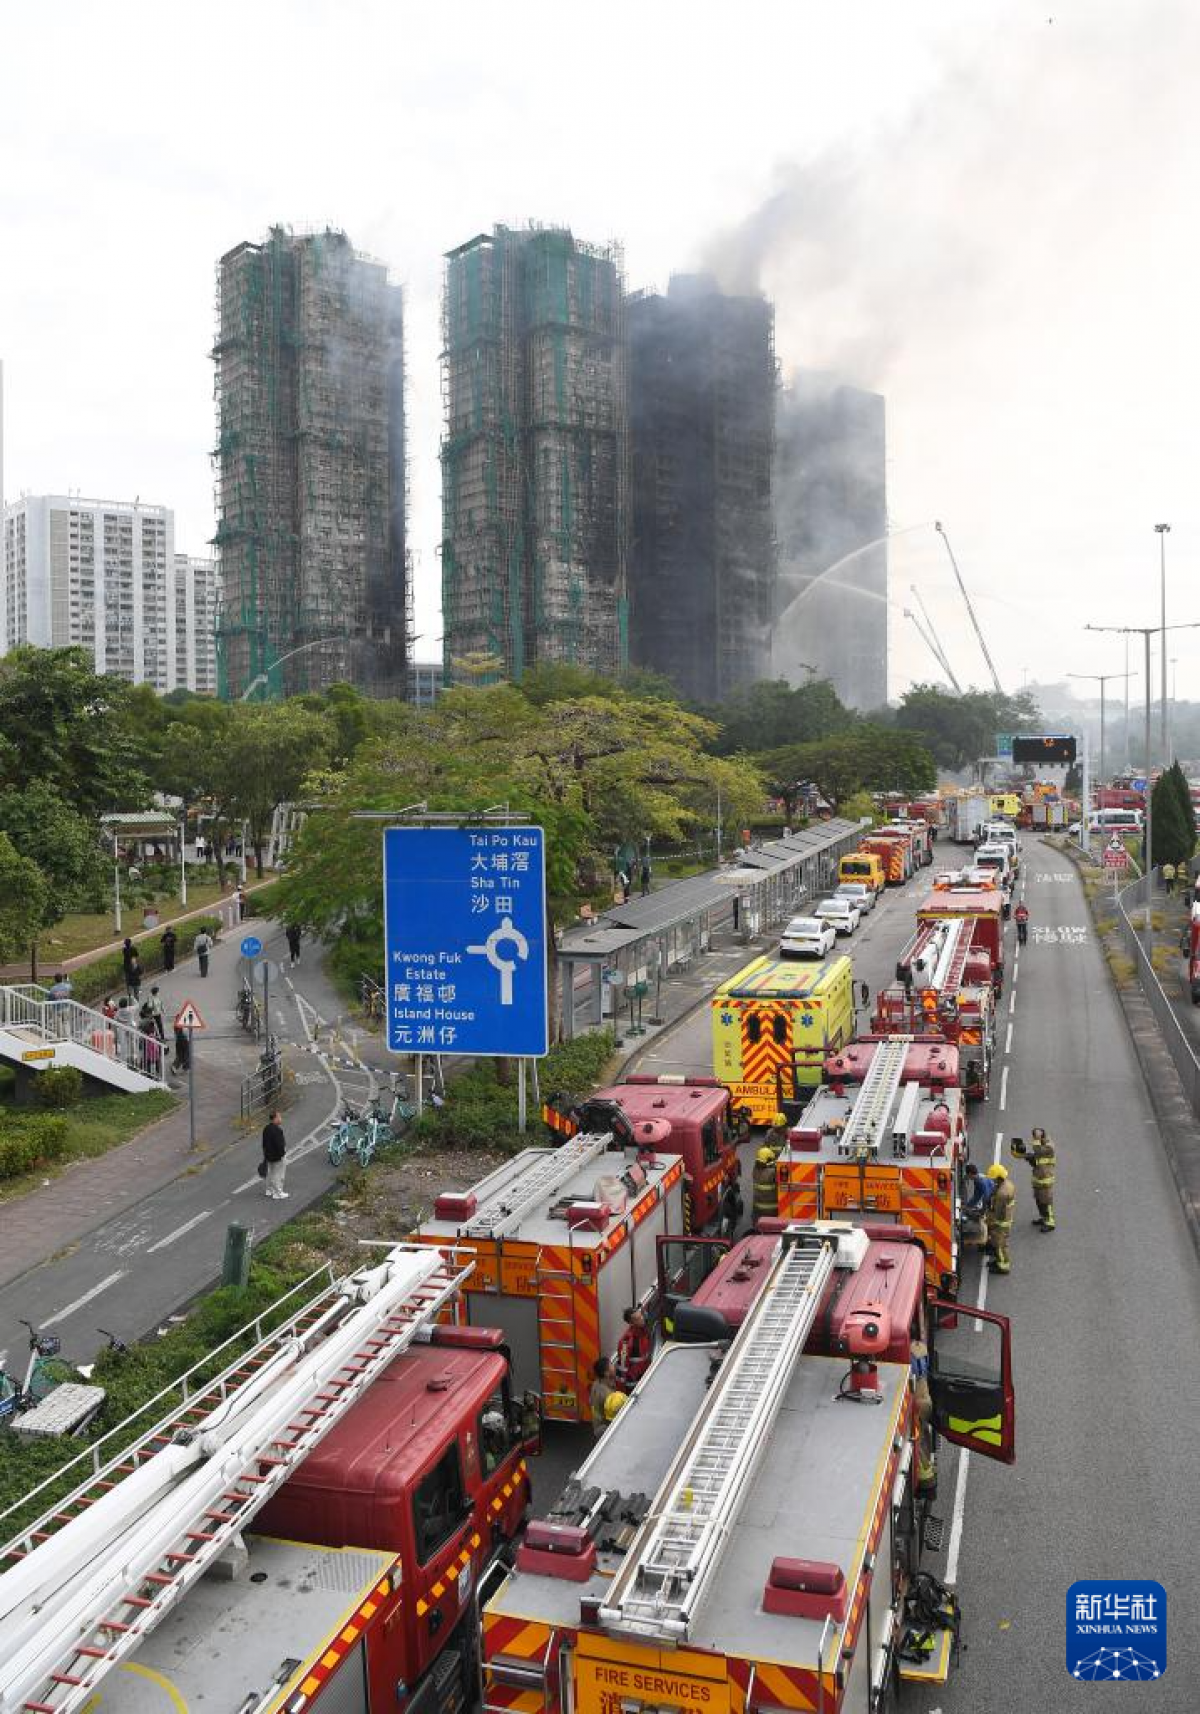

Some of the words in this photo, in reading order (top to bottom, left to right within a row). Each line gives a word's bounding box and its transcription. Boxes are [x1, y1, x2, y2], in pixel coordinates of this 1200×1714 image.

[470, 835, 488, 846] Tai
[492, 835, 508, 846] Po
[513, 835, 537, 846] Kau
[470, 851, 530, 871] 大埔滘
[471, 876, 494, 888] Sha
[499, 876, 520, 889] Tin
[471, 893, 513, 914] 沙田
[393, 951, 435, 965] Kwong
[439, 952, 462, 963] Fuk
[406, 968, 446, 980] Estate
[394, 984, 456, 1003] 廣福邨
[394, 1007, 431, 1019] Island
[434, 1009, 475, 1021] House
[394, 1025, 458, 1045] 元洲仔
[595, 1667, 629, 1687] FIRE
[633, 1674, 711, 1702] SERVICES
